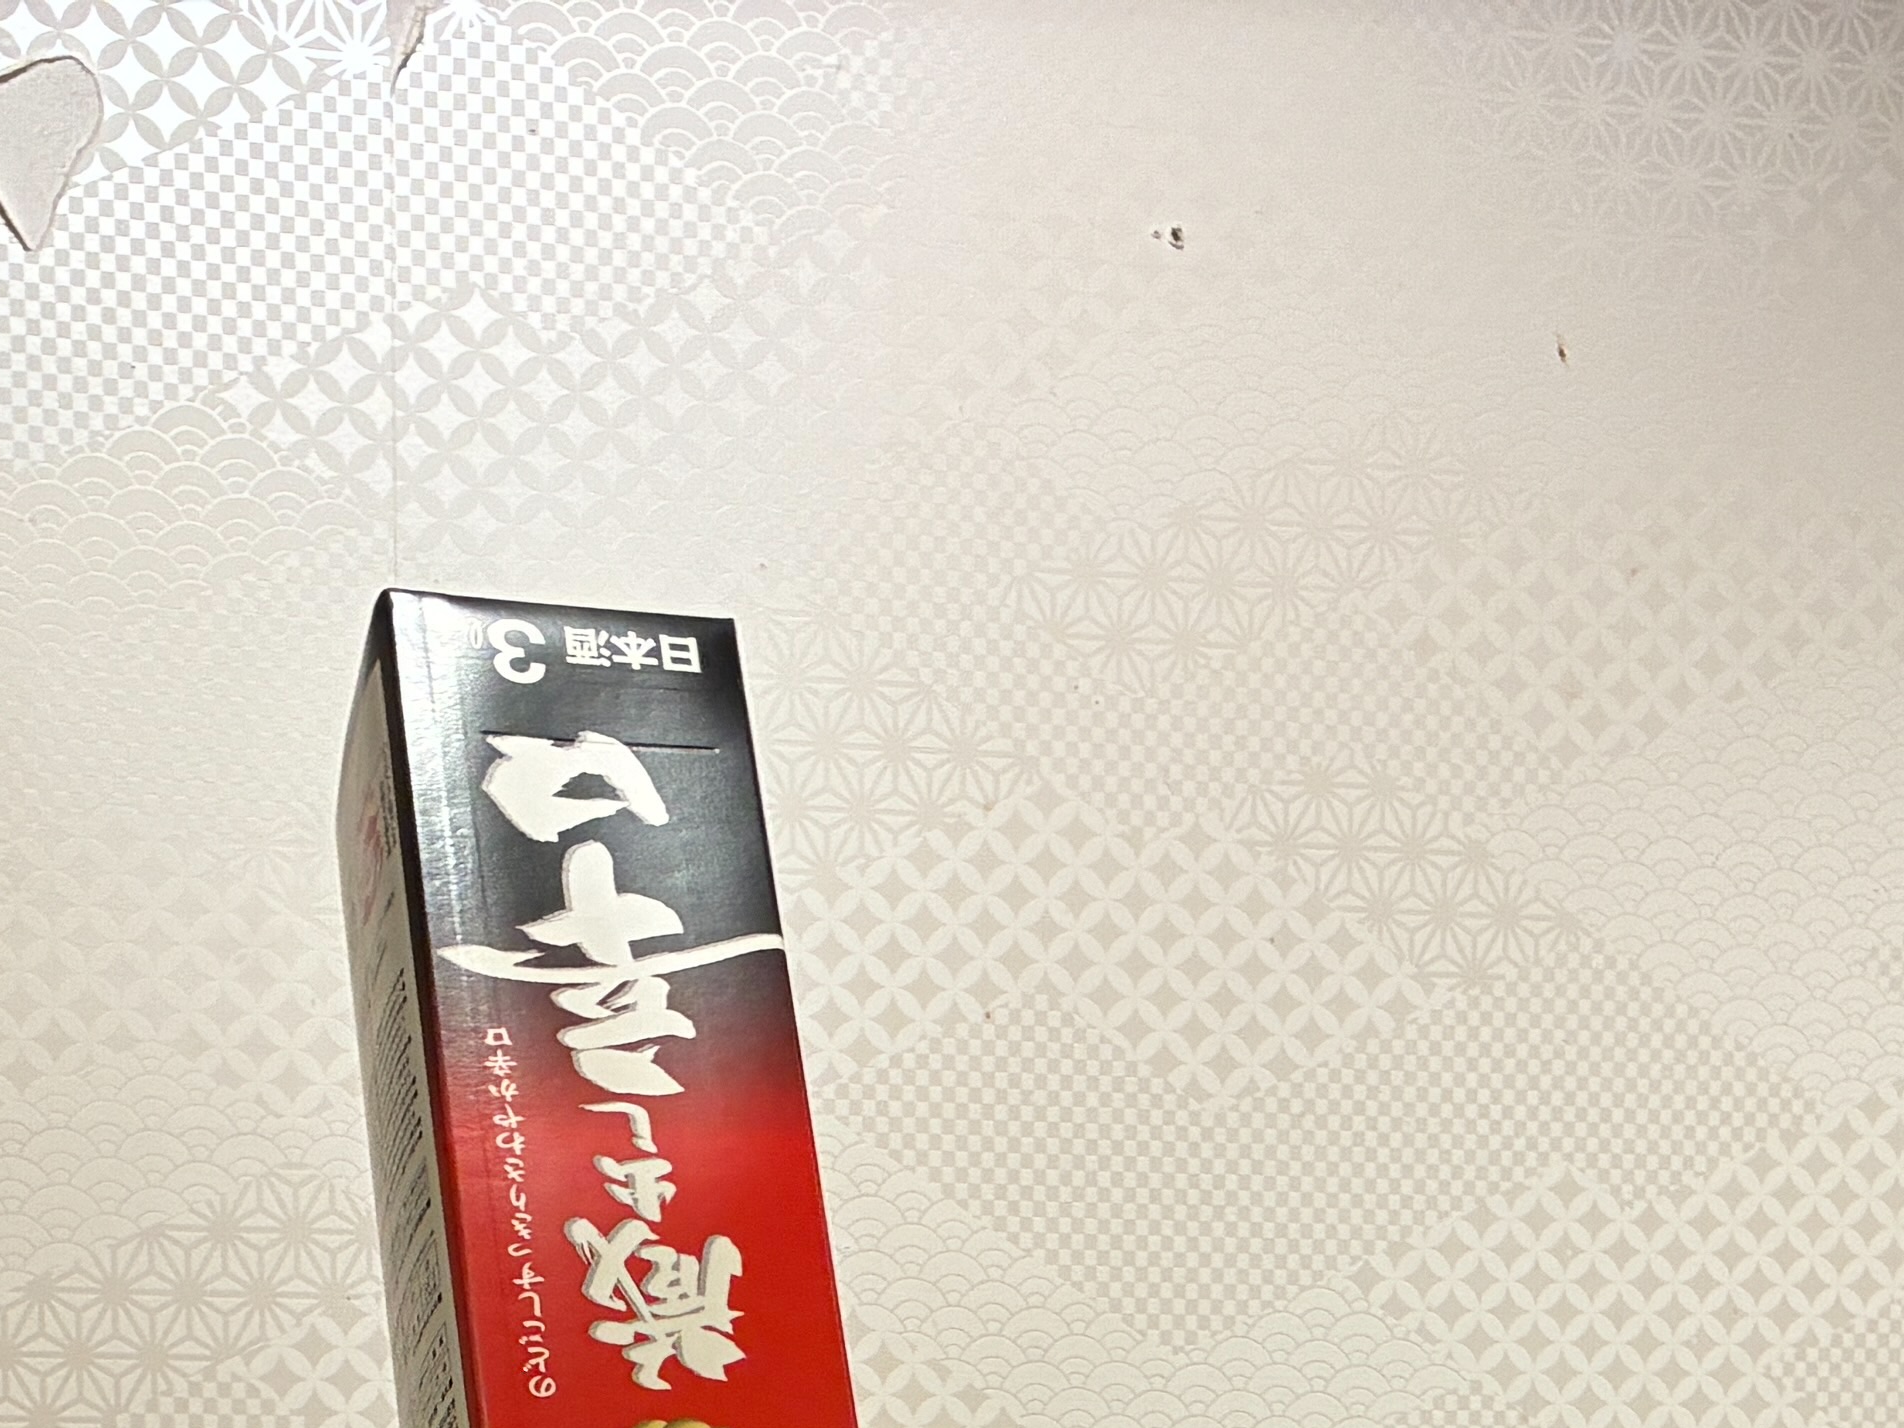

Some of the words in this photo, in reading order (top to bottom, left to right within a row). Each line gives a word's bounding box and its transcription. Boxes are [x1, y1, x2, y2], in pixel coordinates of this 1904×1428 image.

[563, 625, 703, 674] 日本酒
[482, 1027, 558, 1399] のどごしすっきりさわやか辛口
